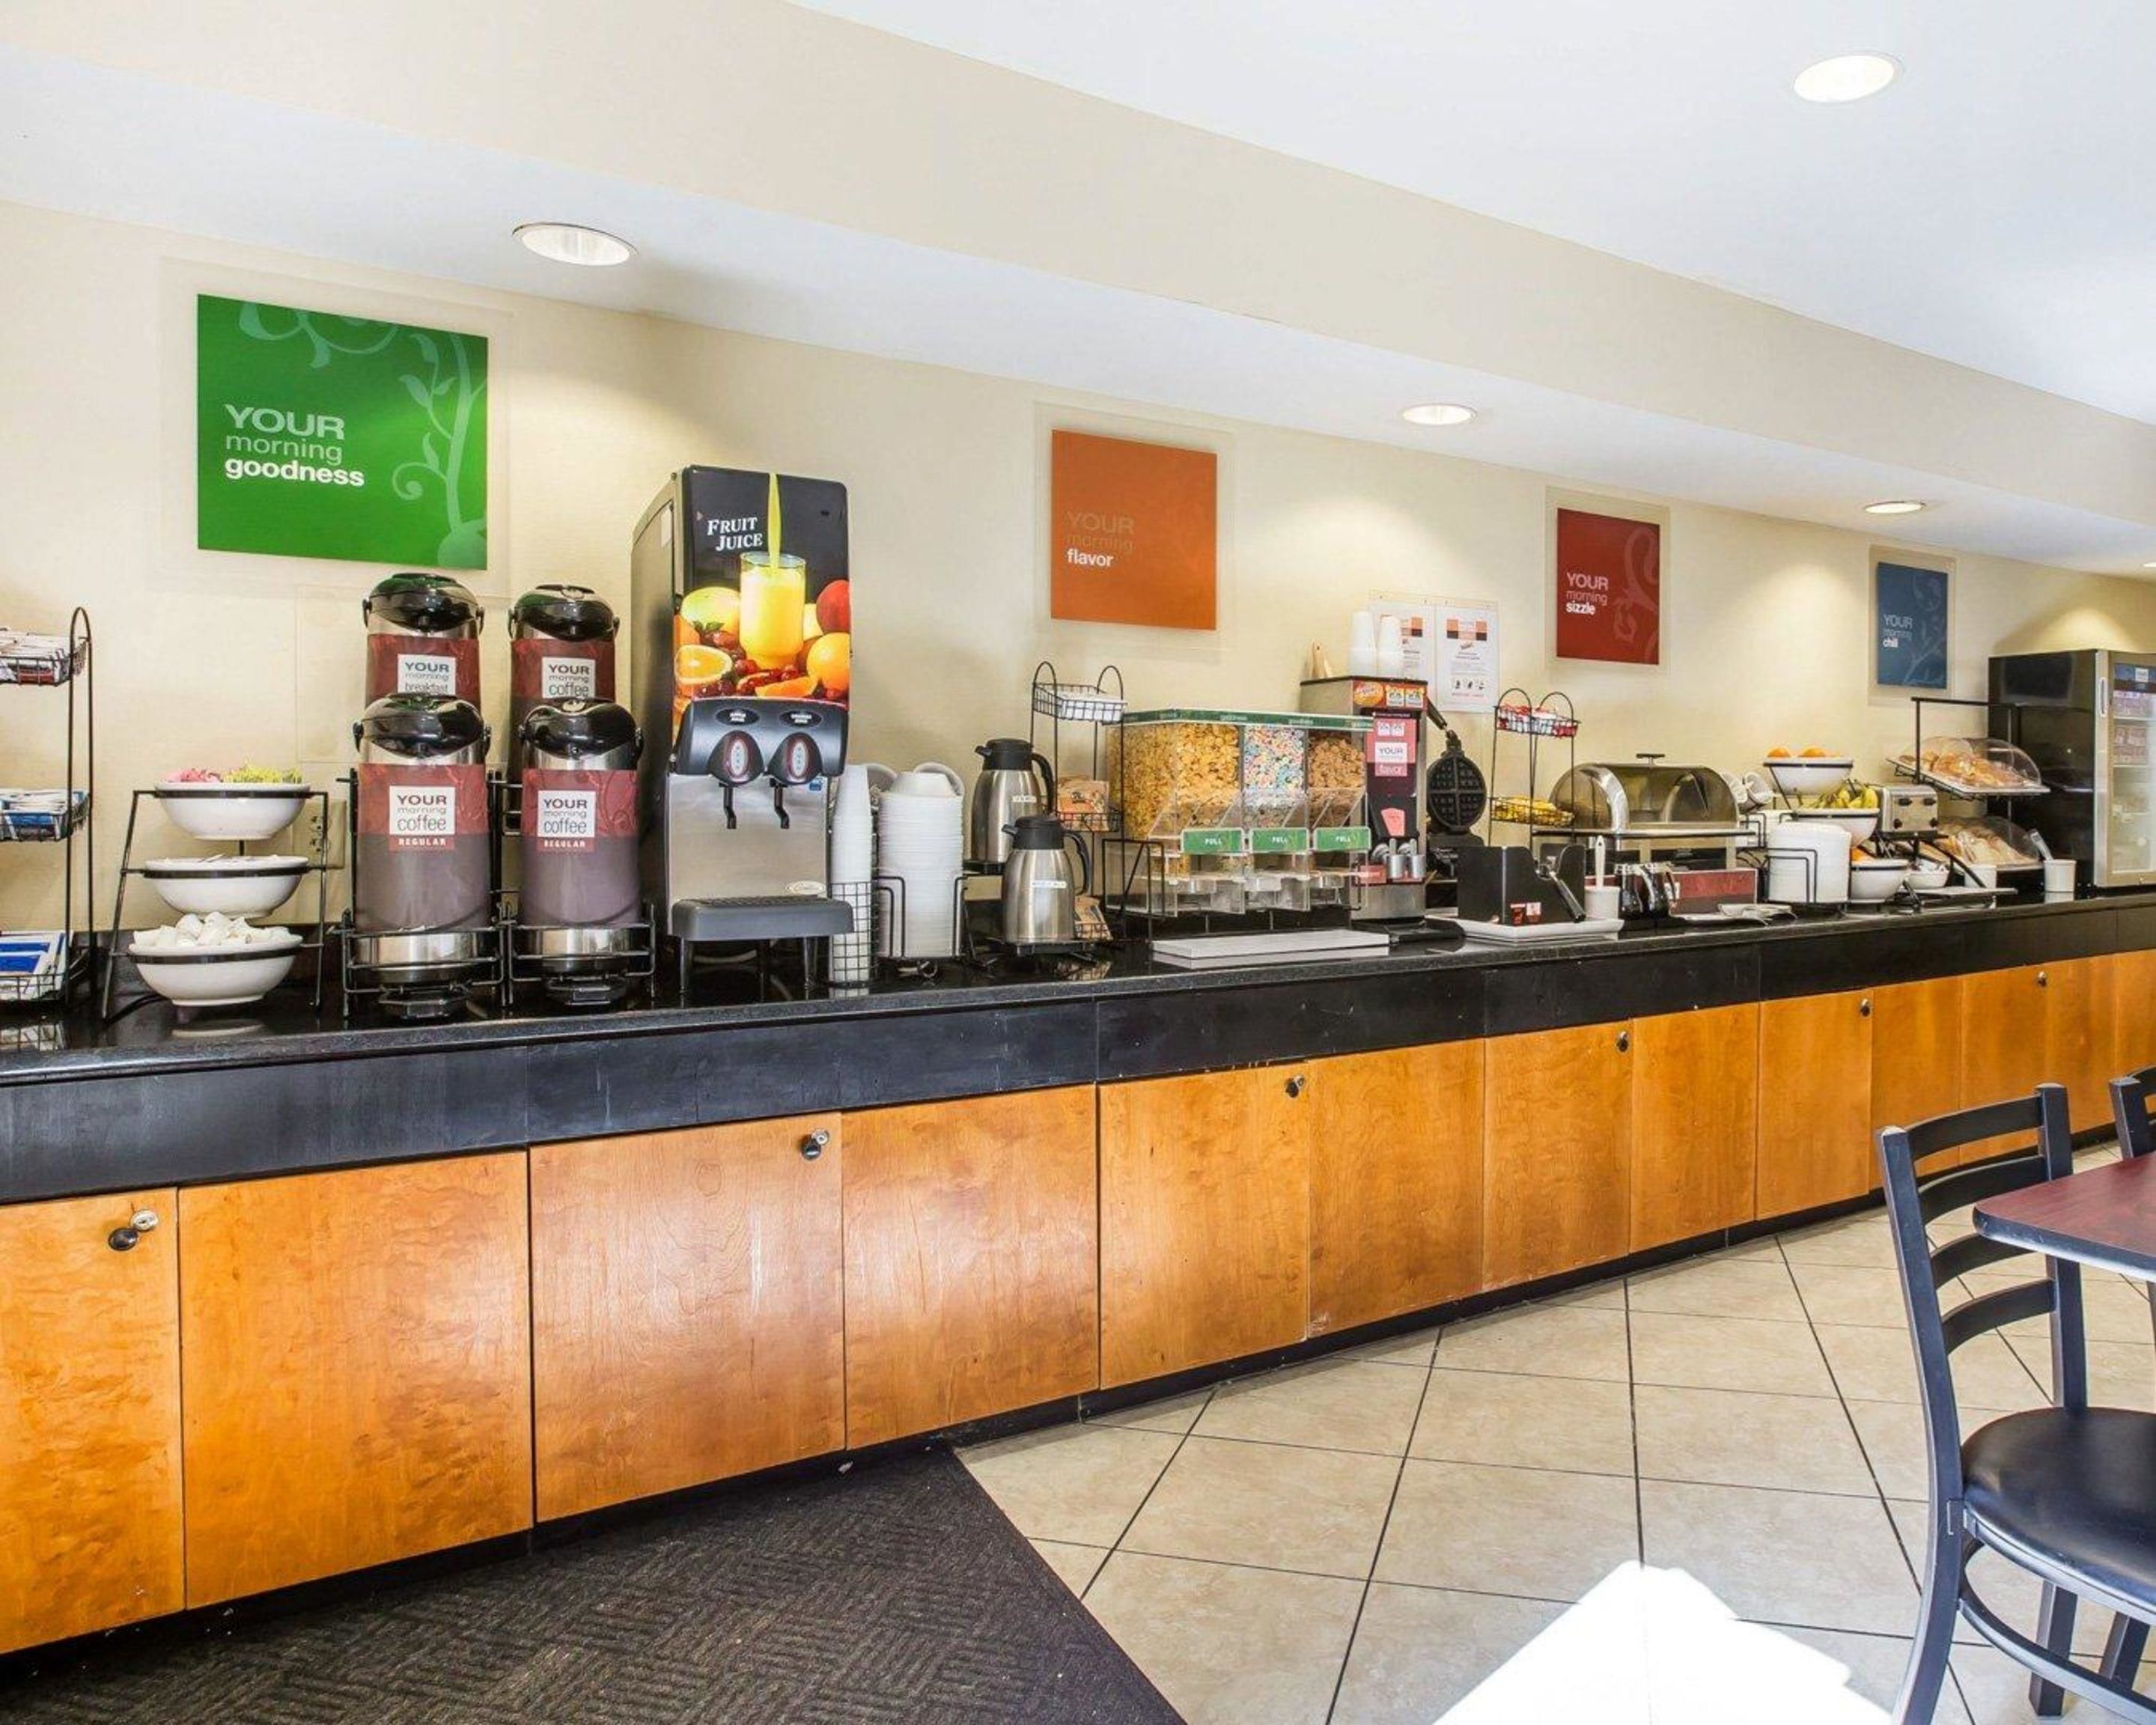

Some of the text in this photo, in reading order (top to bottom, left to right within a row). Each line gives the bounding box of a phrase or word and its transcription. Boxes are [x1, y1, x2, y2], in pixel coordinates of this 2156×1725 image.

[225, 404, 345, 440] YOUR
[226, 434, 343, 466] morning
[225, 457, 365, 487] goodness
[706, 515, 758, 536] FRUIT
[1065, 511, 1135, 535] YOUR
[715, 532, 764, 552] JUICE
[1065, 535, 1135, 555] morning
[1066, 547, 1115, 568] flavor
[1566, 572, 1609, 591] YOUR
[1566, 590, 1608, 606] morning
[1565, 600, 1596, 615] sizzle
[1883, 614, 1913, 629] YOUR
[404, 662, 450, 673] YOUR
[548, 663, 591, 675] YOUR
[548, 675, 590, 684] morning
[548, 681, 590, 697] coffee
[397, 794, 447, 806] YOUR
[543, 798, 588, 809] YOUR
[397, 814, 447, 832] coffee
[543, 817, 588, 834] coffee
[398, 838, 447, 846] REGULAR
[544, 839, 586, 848] REGULAR
[1205, 838, 1222, 846] PULL
